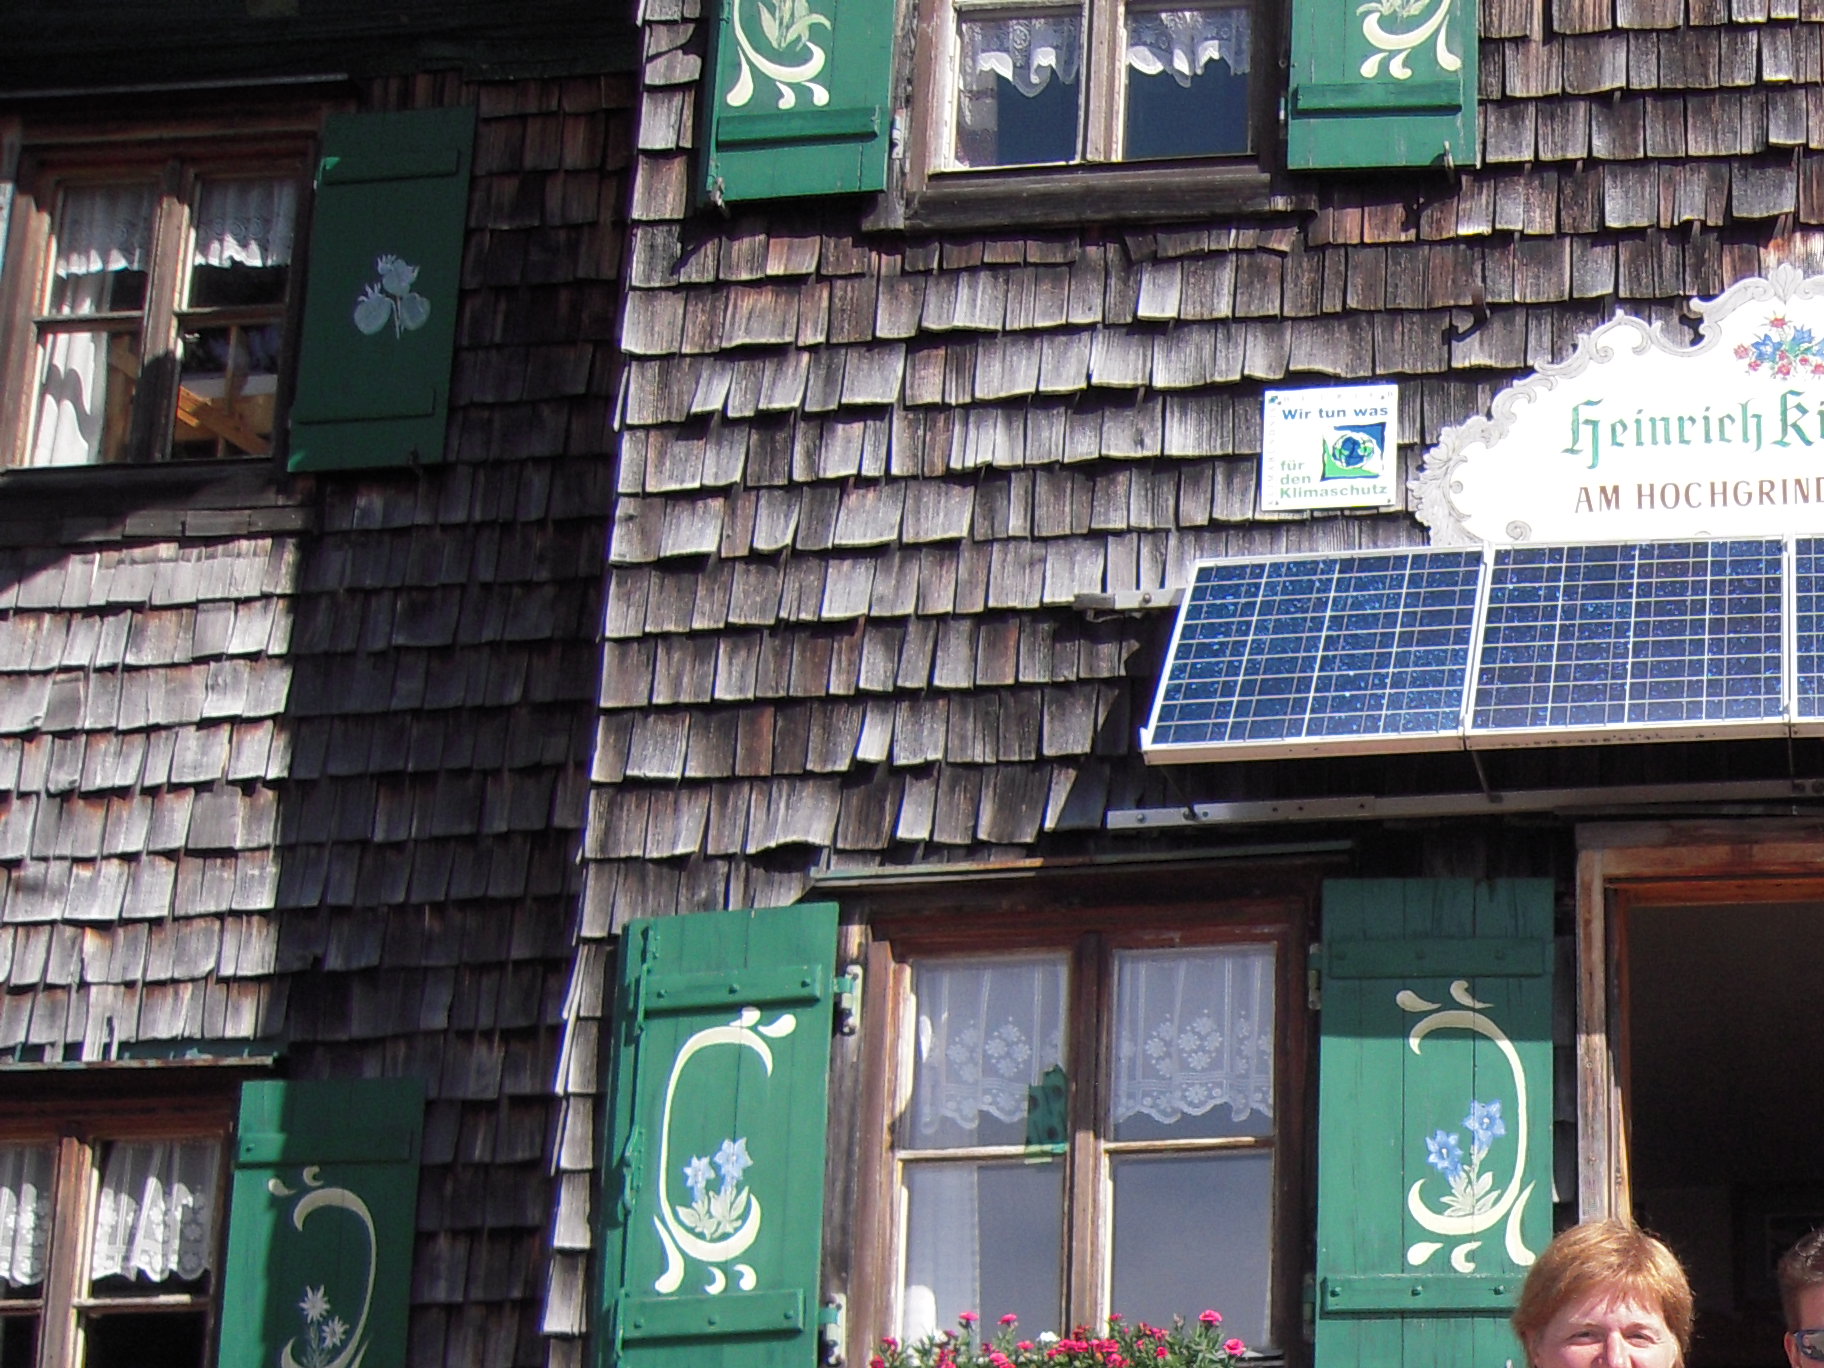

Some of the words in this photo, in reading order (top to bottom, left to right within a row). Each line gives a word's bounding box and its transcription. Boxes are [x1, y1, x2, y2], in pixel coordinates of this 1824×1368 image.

[1282, 409, 1312, 420] Wir
[1318, 407, 1346, 419] tun
[1353, 407, 1388, 417] was
[1560, 398, 1763, 470] Heinrich
[1280, 460, 1305, 472] für
[1280, 474, 1311, 486] den
[1280, 484, 1388, 499] Klimaschutz
[1574, 484, 1620, 513] AM
